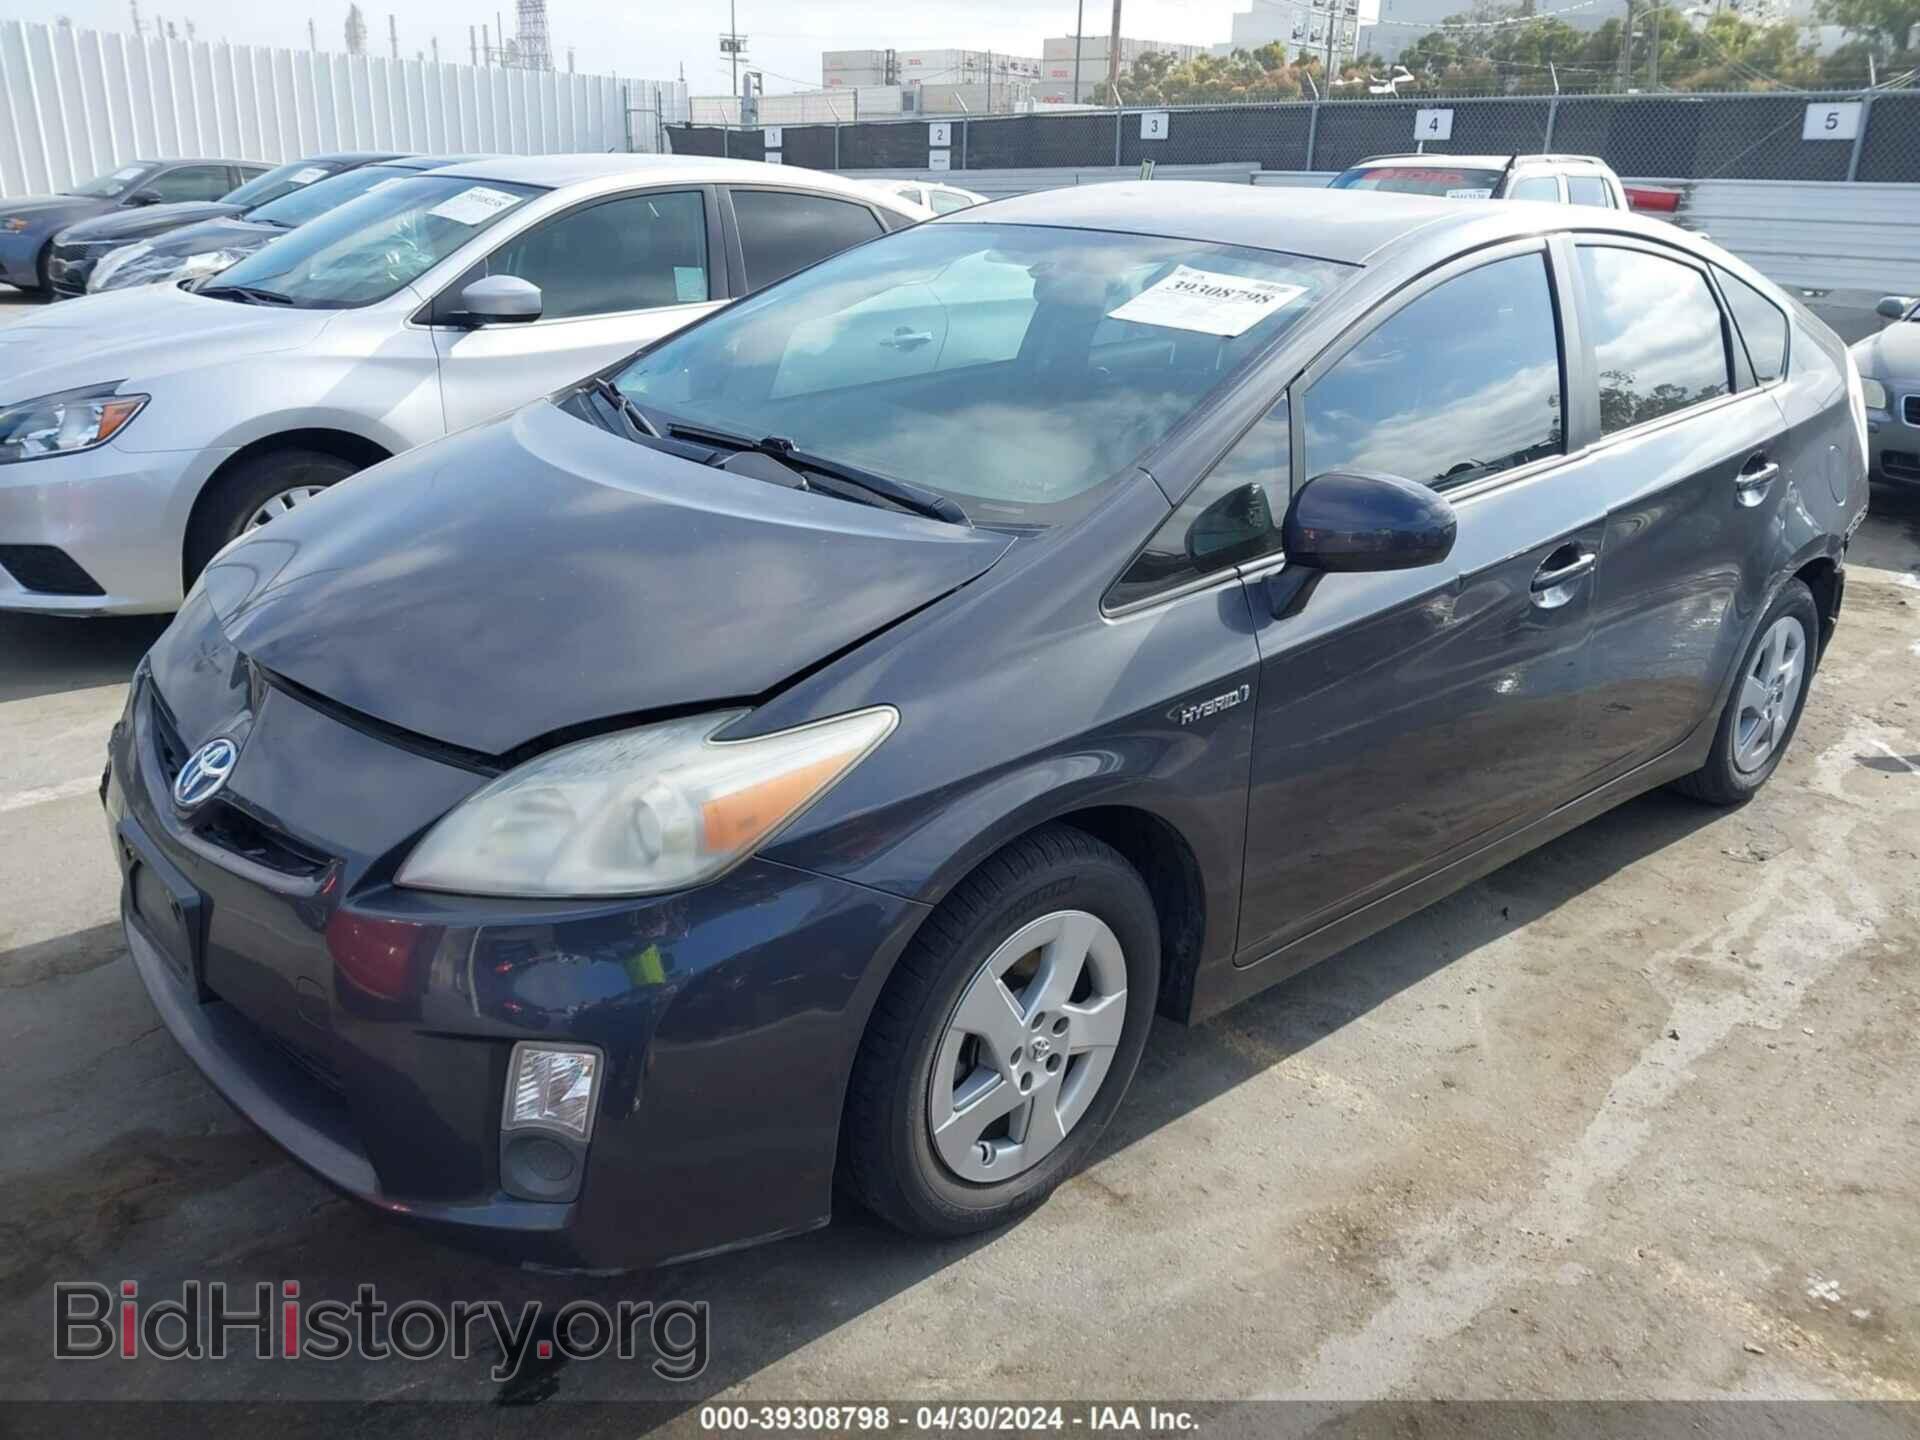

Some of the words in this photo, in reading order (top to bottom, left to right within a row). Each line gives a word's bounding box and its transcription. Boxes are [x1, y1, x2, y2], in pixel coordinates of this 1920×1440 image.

[1151, 119, 1159, 133] 3
[1428, 116, 1439, 133] 4
[1824, 111, 1840, 130] 5
[936, 129, 944, 141] 2
[1166, 280, 1276, 304] 39308798
[1181, 690, 1241, 725] HYBRID
